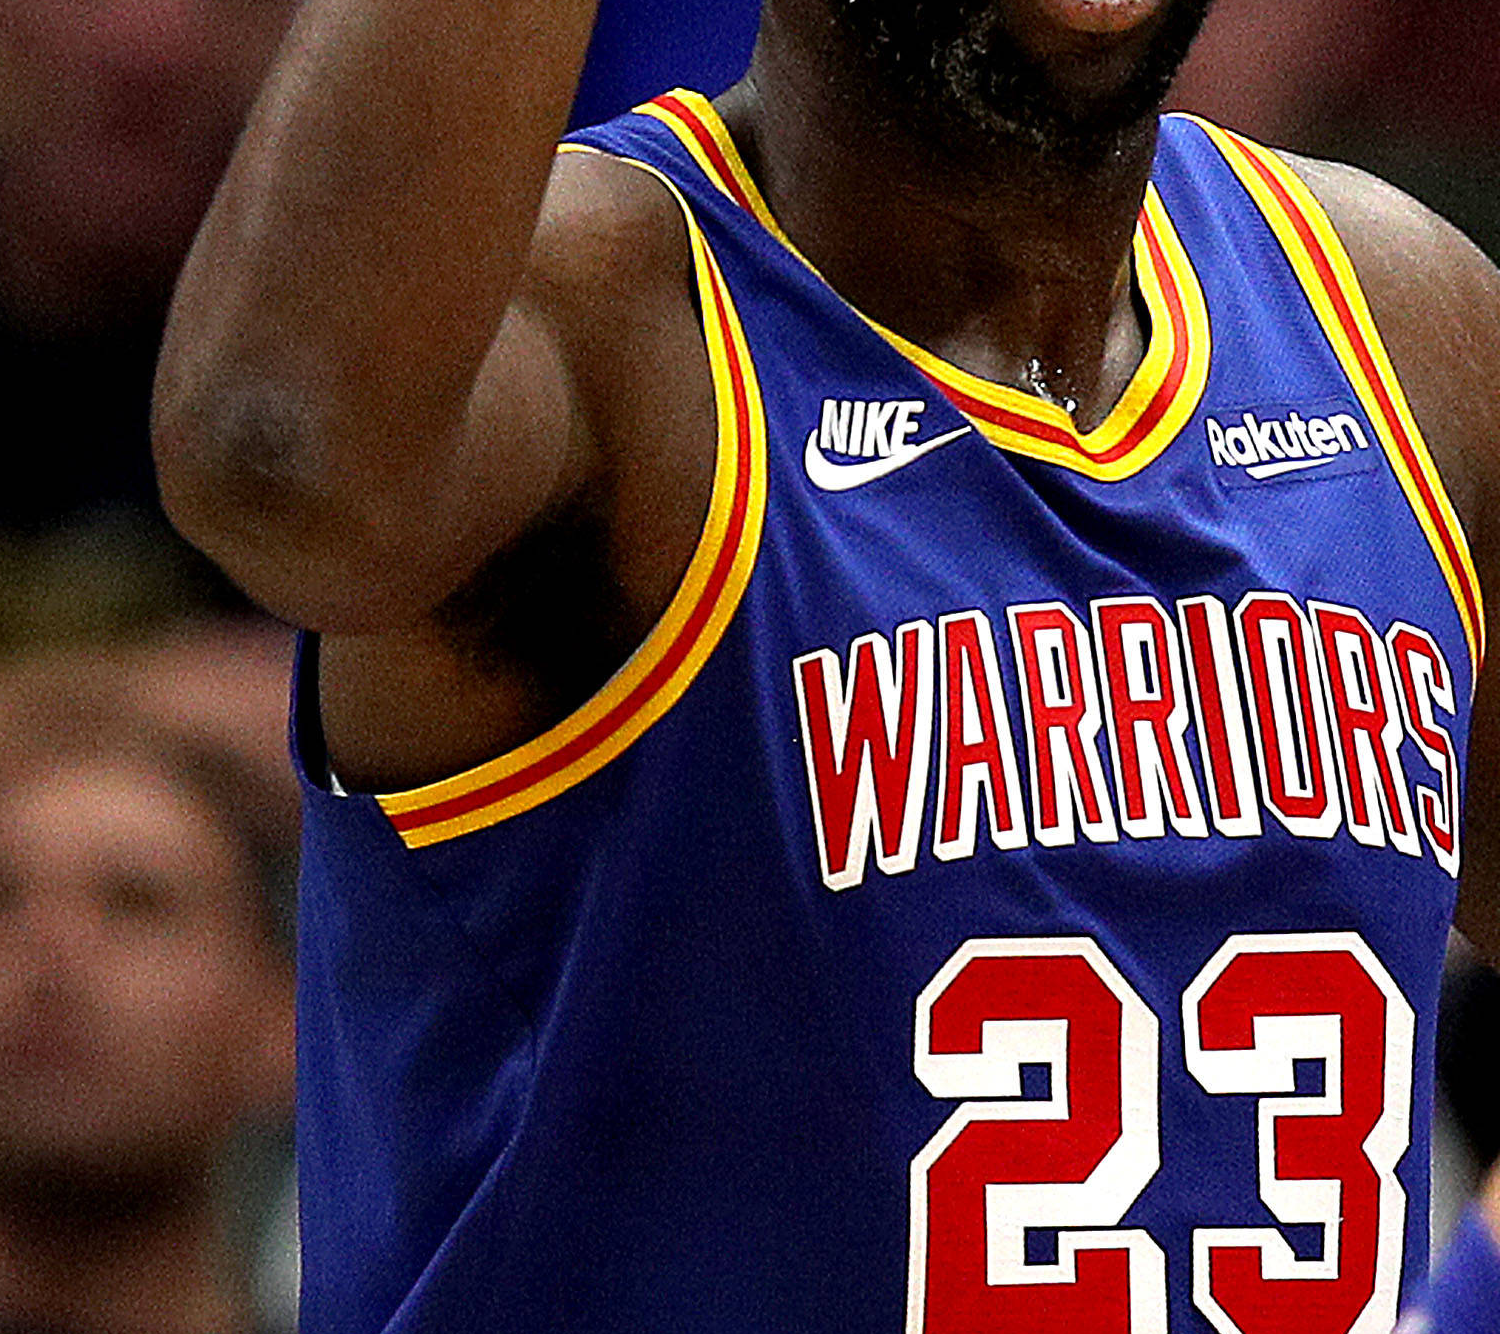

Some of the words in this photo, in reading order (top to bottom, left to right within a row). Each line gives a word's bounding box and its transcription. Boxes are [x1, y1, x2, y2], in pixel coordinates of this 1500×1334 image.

[820, 399, 925, 457] NIKE
[1206, 412, 1369, 466] Rakuten
[793, 592, 1460, 891] WARRIORS
